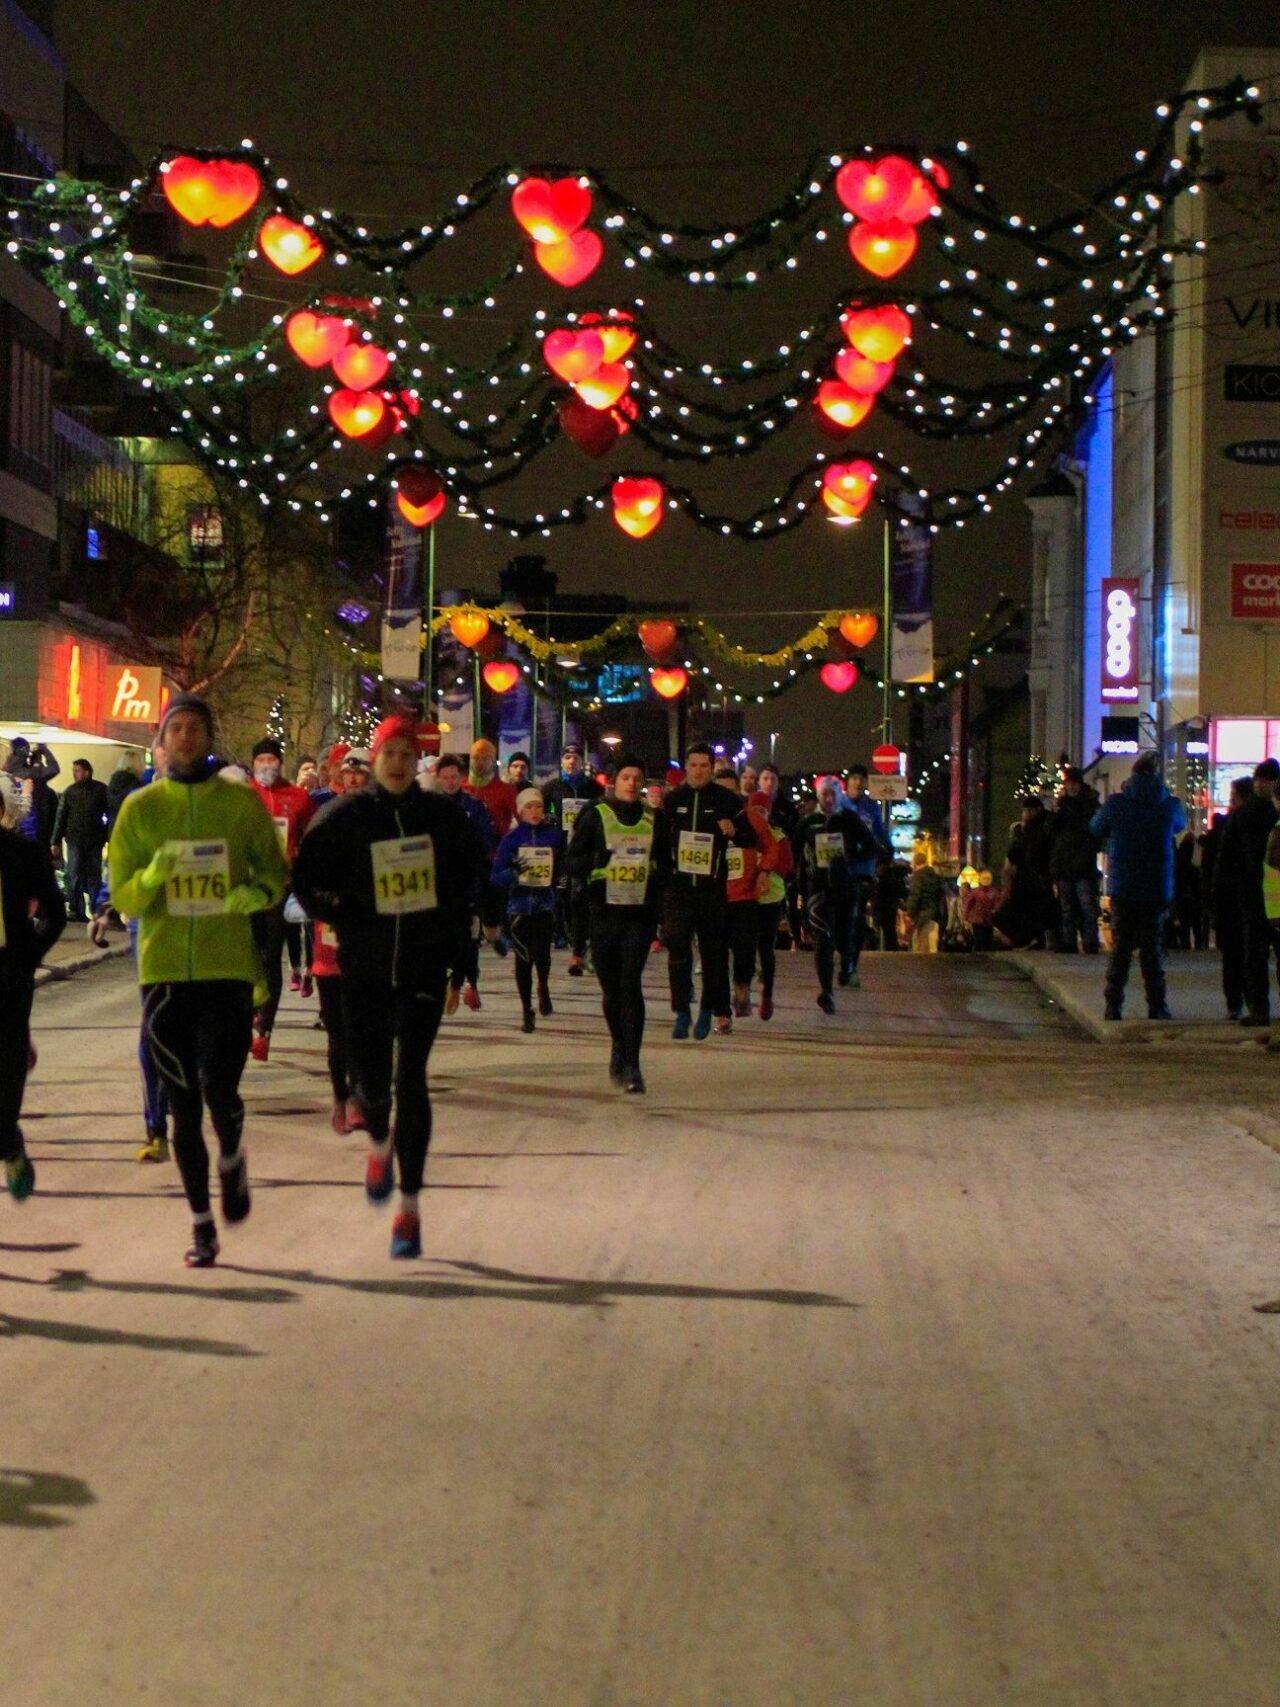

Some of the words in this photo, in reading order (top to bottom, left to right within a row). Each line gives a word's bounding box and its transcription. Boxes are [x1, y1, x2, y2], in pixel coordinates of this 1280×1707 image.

[680, 850, 709, 866] 1464
[171, 873, 225, 899] 1176
[379, 869, 430, 898] 1341
